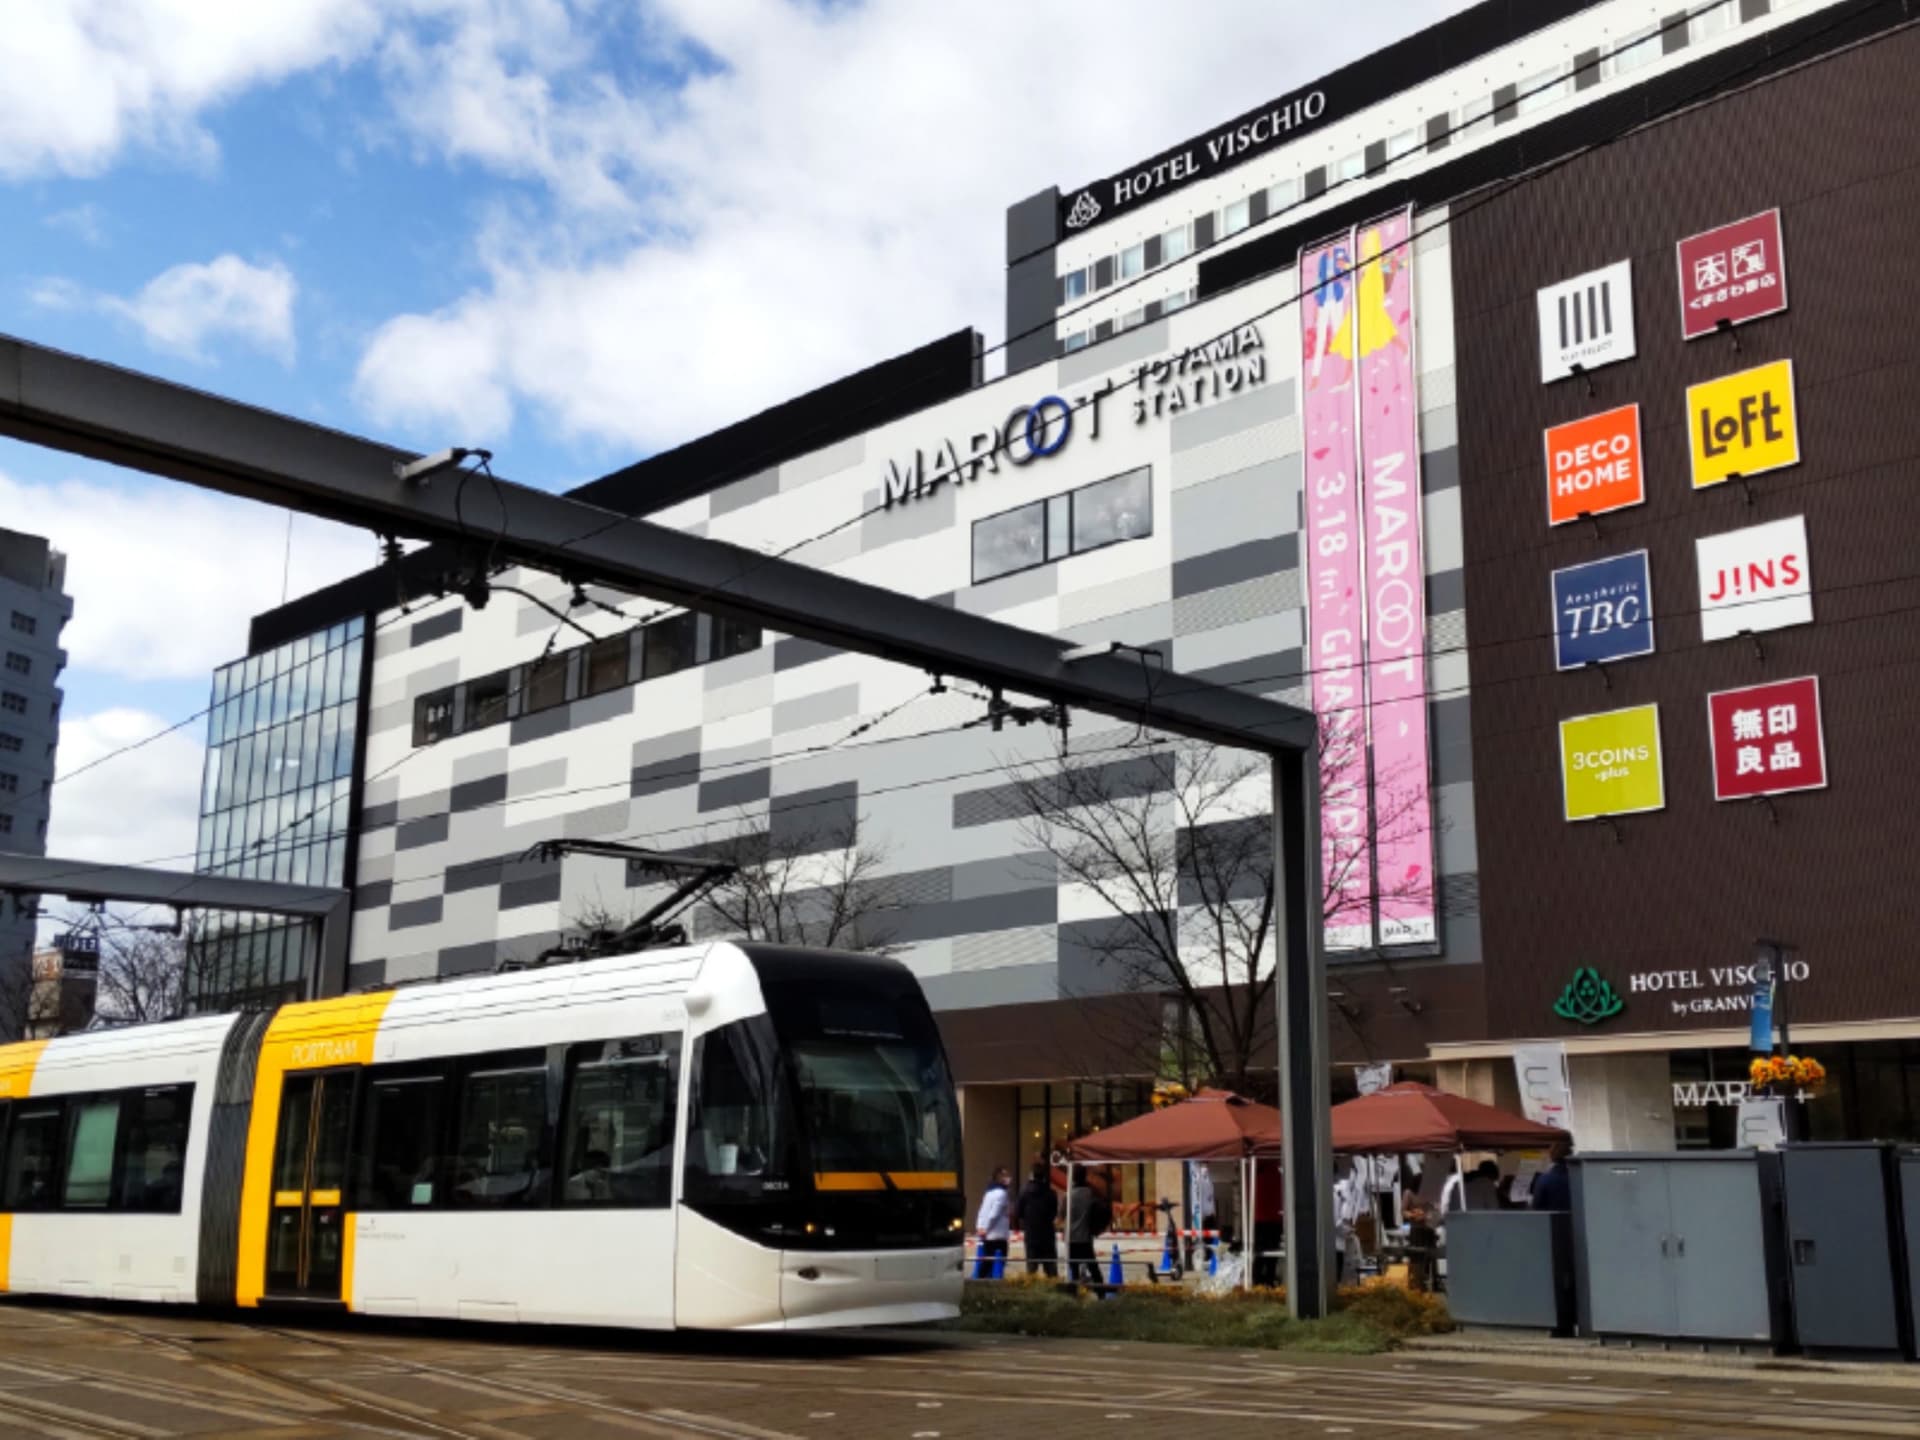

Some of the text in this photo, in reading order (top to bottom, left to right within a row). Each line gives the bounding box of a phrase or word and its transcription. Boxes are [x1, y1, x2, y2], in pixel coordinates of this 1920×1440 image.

[1114, 90, 1326, 205] HOTEL VISCHIO
[1130, 324, 1265, 391] TOYAMA
[1132, 354, 1267, 425] STATION
[880, 377, 1114, 510] MAROOT
[1555, 433, 1631, 472] DECO
[1555, 459, 1632, 497] HOME
[1315, 471, 1348, 557] 3.18
[1372, 451, 1415, 684] MAROOT
[1563, 595, 1640, 640] TBC
[1320, 627, 1355, 767] GRAND
[1731, 703, 1799, 741] 無印
[1572, 744, 1650, 770] 3COINS
[1735, 741, 1801, 776] 良品
[1326, 780, 1362, 890] OPEN
[1629, 969, 1705, 993] HOTEL
[1671, 994, 1756, 1018] by GRANVI
